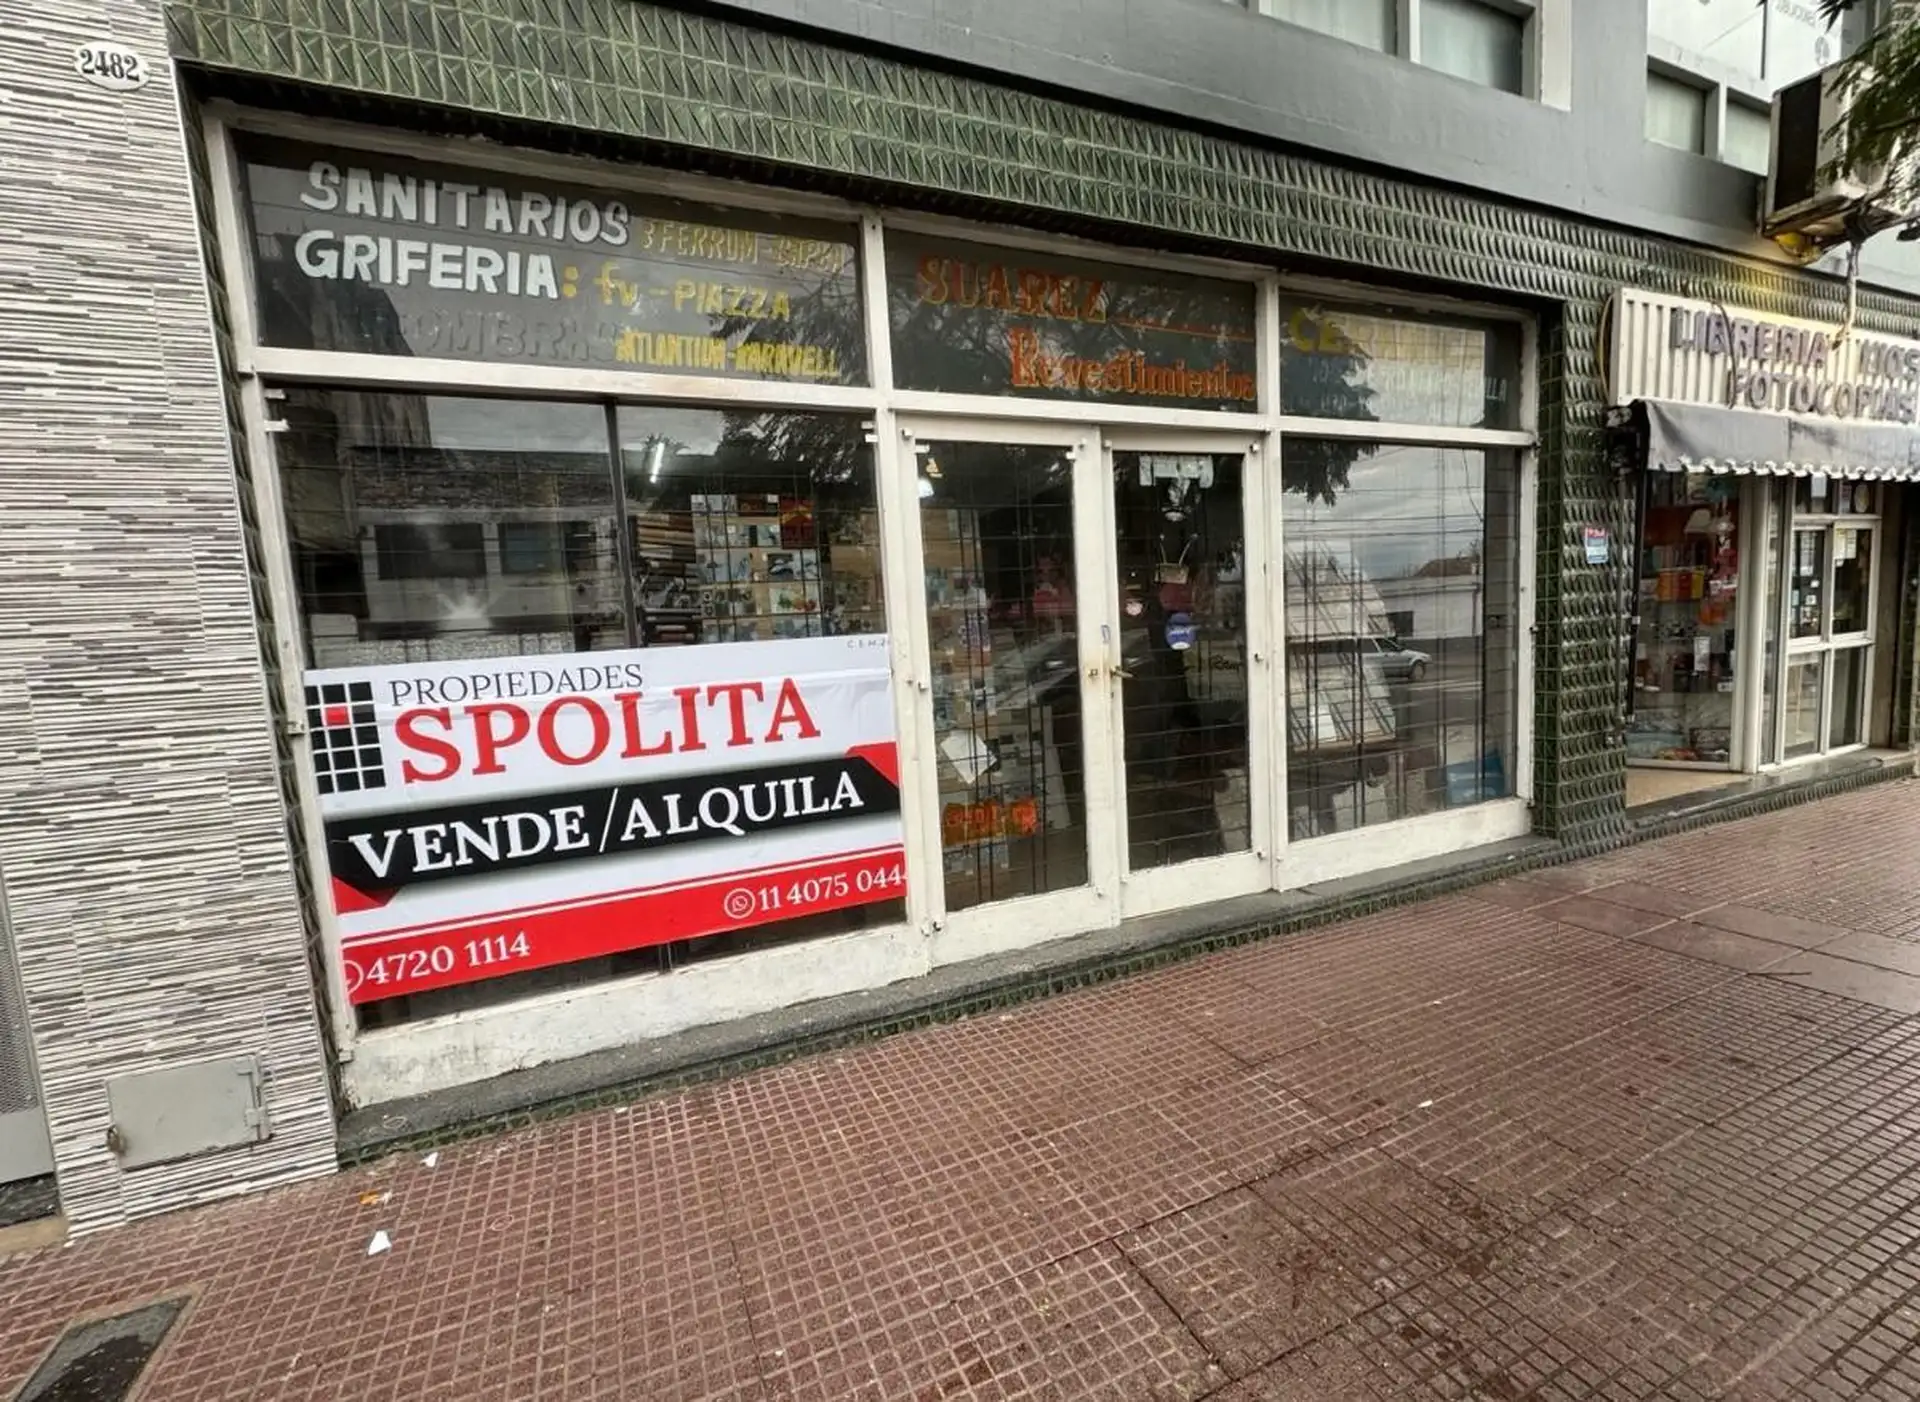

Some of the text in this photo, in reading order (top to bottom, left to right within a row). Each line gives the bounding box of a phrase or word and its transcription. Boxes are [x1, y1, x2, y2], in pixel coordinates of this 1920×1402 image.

[80, 48, 140, 82] 2482
[300, 161, 629, 246] SANITARIOS
[295, 229, 579, 300] GRIFERIA:
[674, 279, 790, 322] PIAZZA
[1670, 307, 1829, 368] LIBRERIA
[1727, 368, 1917, 424] FOTOCOPIAS
[389, 664, 643, 706] PROPIEDADES
[395, 677, 821, 785] SPOLITA
[759, 885, 781, 911] 11
[787, 872, 849, 905] 4075
[366, 930, 531, 985] 4720 1114
